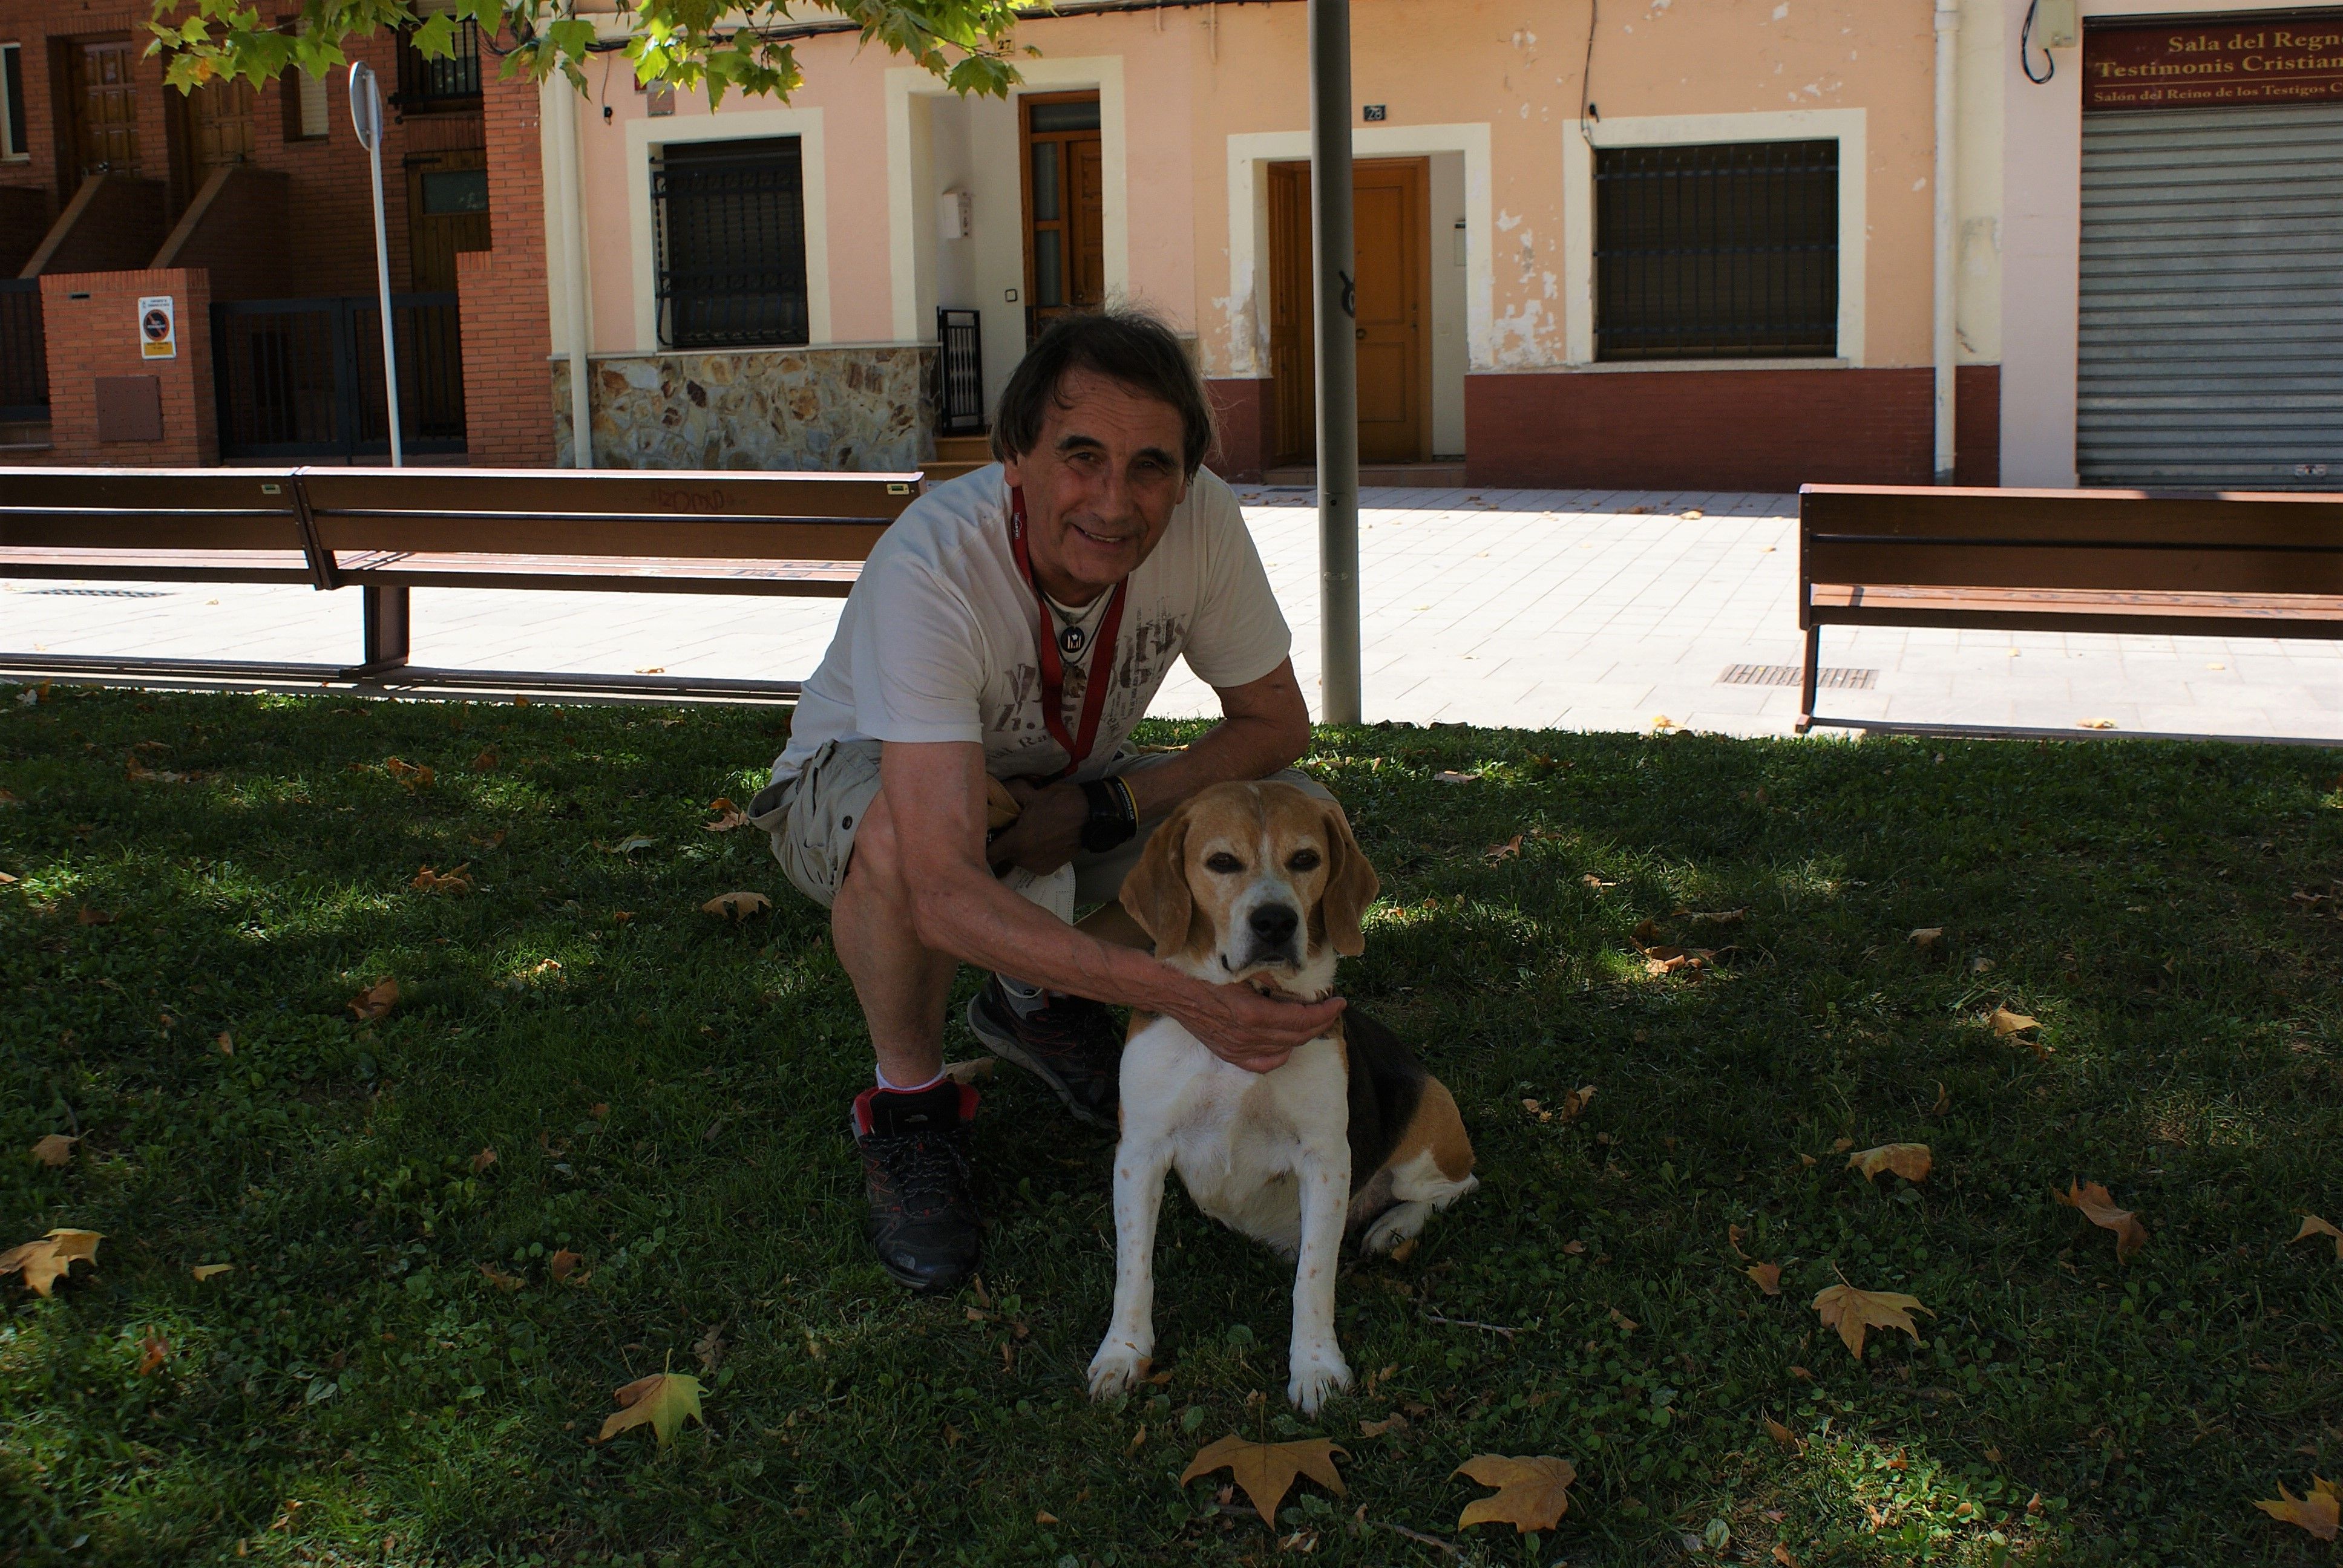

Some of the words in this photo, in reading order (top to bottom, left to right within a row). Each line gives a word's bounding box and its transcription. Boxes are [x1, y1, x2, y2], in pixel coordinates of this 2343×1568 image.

[997, 39, 1011, 49] 27
[2169, 34, 2221, 52] Sala
[2227, 33, 2265, 50] del
[2273, 32, 2343, 51] Regn
[2095, 59, 2234, 77] Testimonis
[2094, 91, 2136, 102] Salón
[2140, 90, 2162, 100] del
[2168, 89, 2211, 99] Reino
[2215, 87, 2233, 97] de
[2236, 87, 2259, 97] los
[2261, 85, 2325, 97] Testigos
